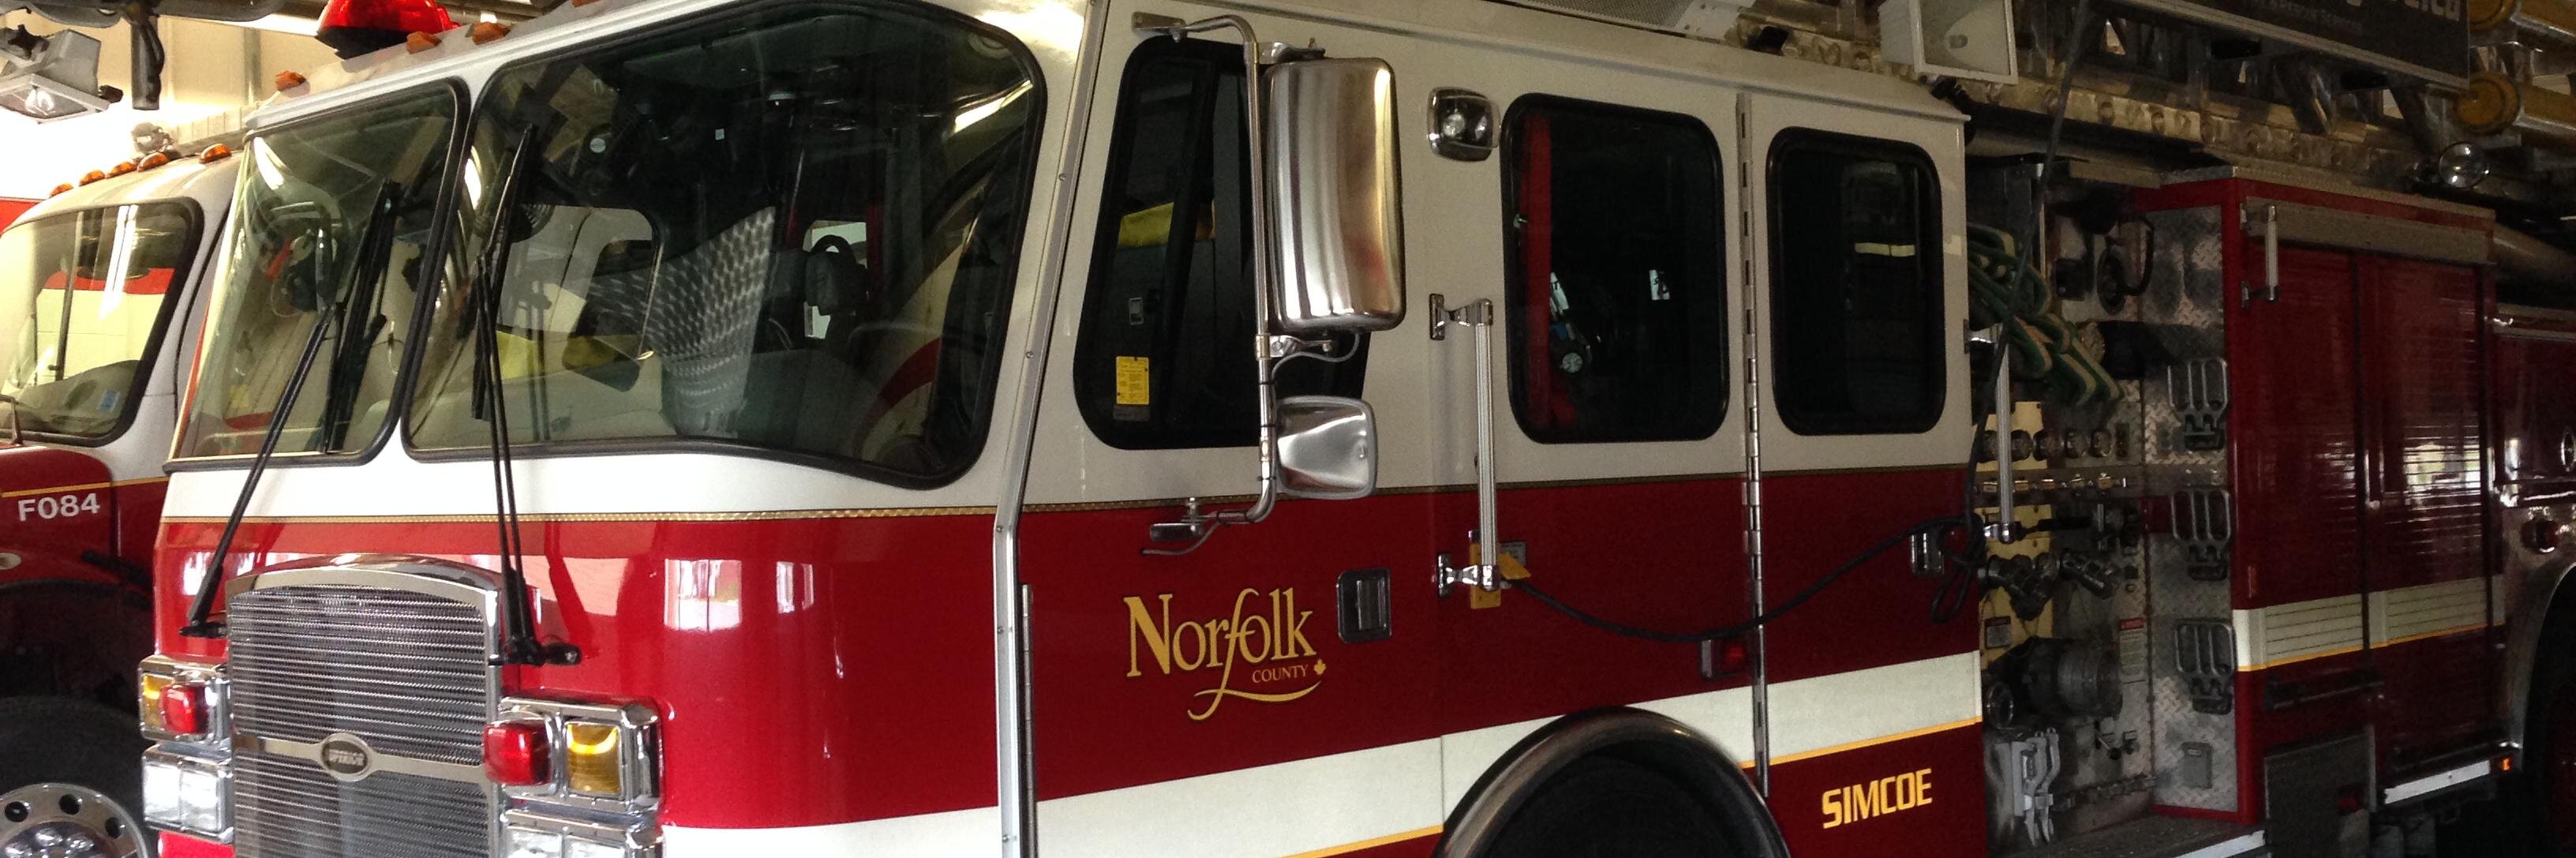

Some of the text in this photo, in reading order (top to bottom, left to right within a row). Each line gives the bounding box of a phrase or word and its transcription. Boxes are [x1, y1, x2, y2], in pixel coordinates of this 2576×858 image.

[1124, 587, 1317, 720] Norfolk
[1252, 664, 1309, 684] COUNTY
[1822, 768, 1933, 829] SIMCOE
